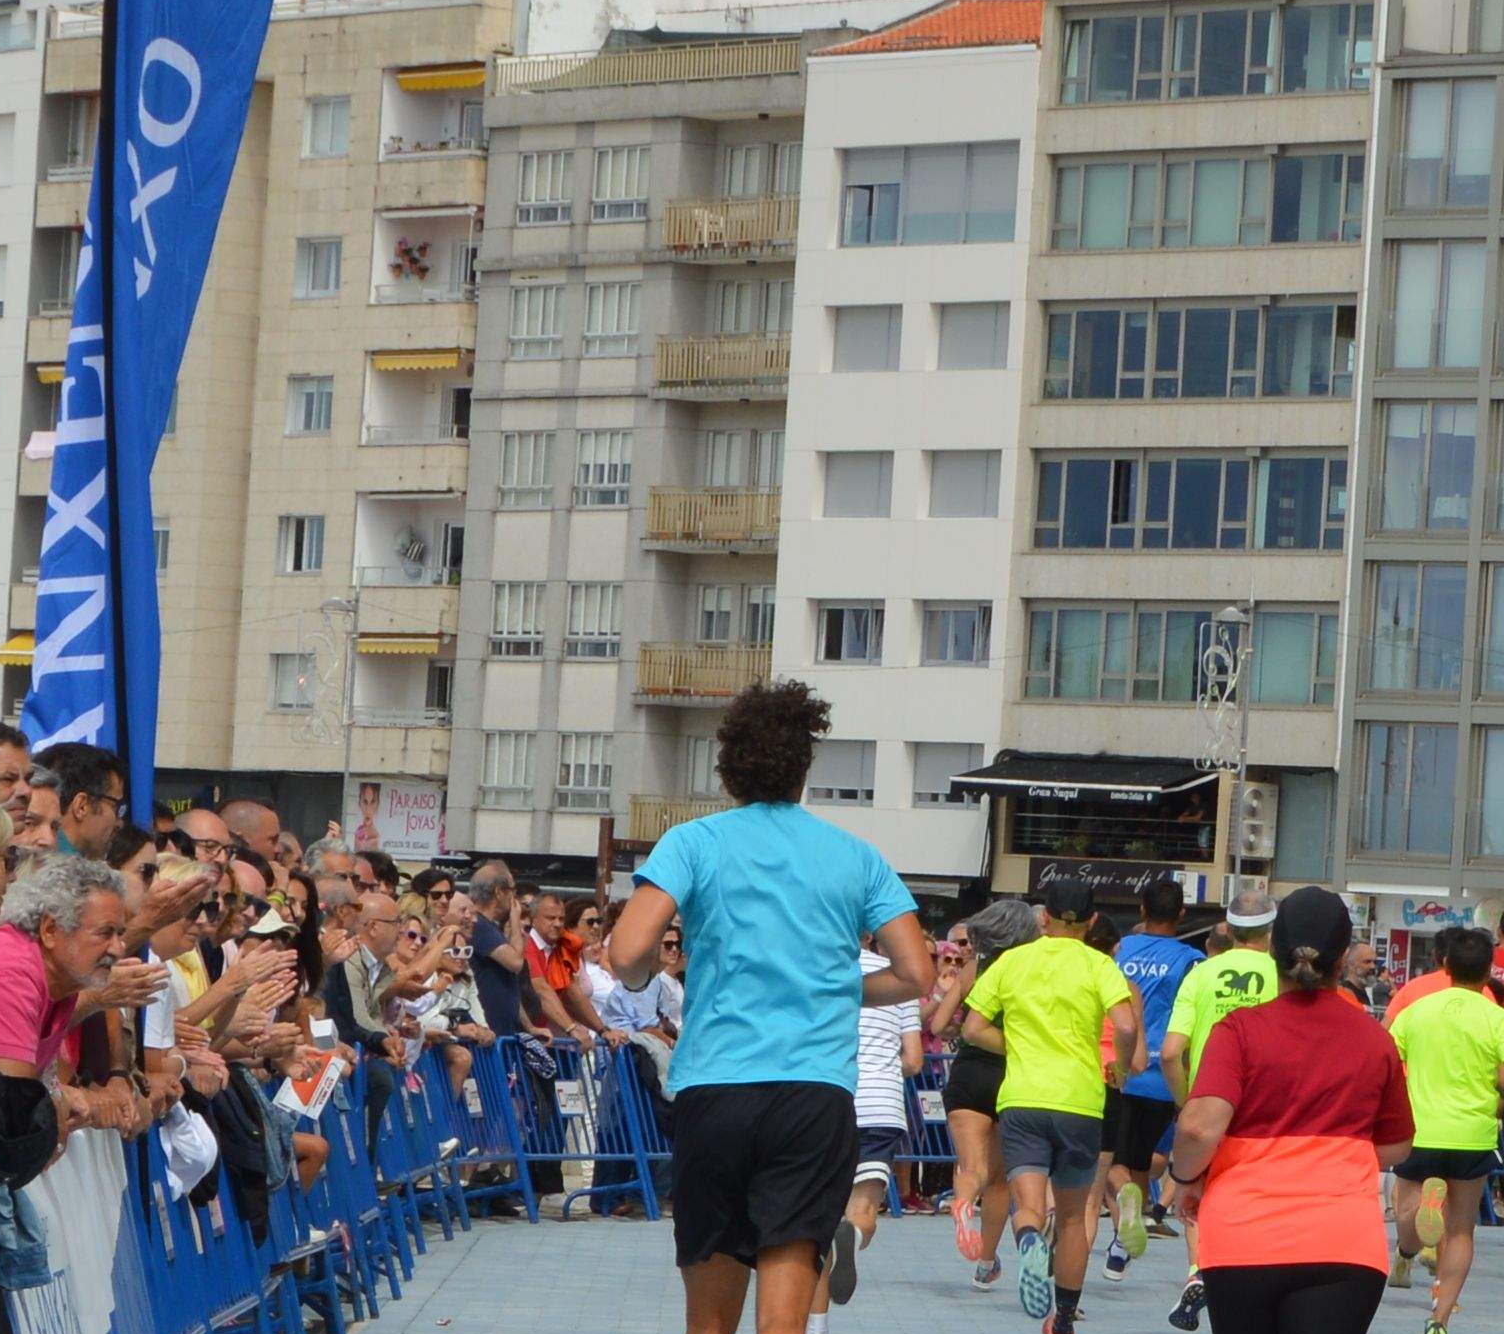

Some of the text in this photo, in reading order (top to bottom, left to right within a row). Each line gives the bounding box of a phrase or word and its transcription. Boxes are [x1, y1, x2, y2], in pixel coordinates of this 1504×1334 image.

[390, 788, 437, 819] PARAISO
[405, 811, 435, 837] JOYAS
[1215, 969, 1265, 999] 30
